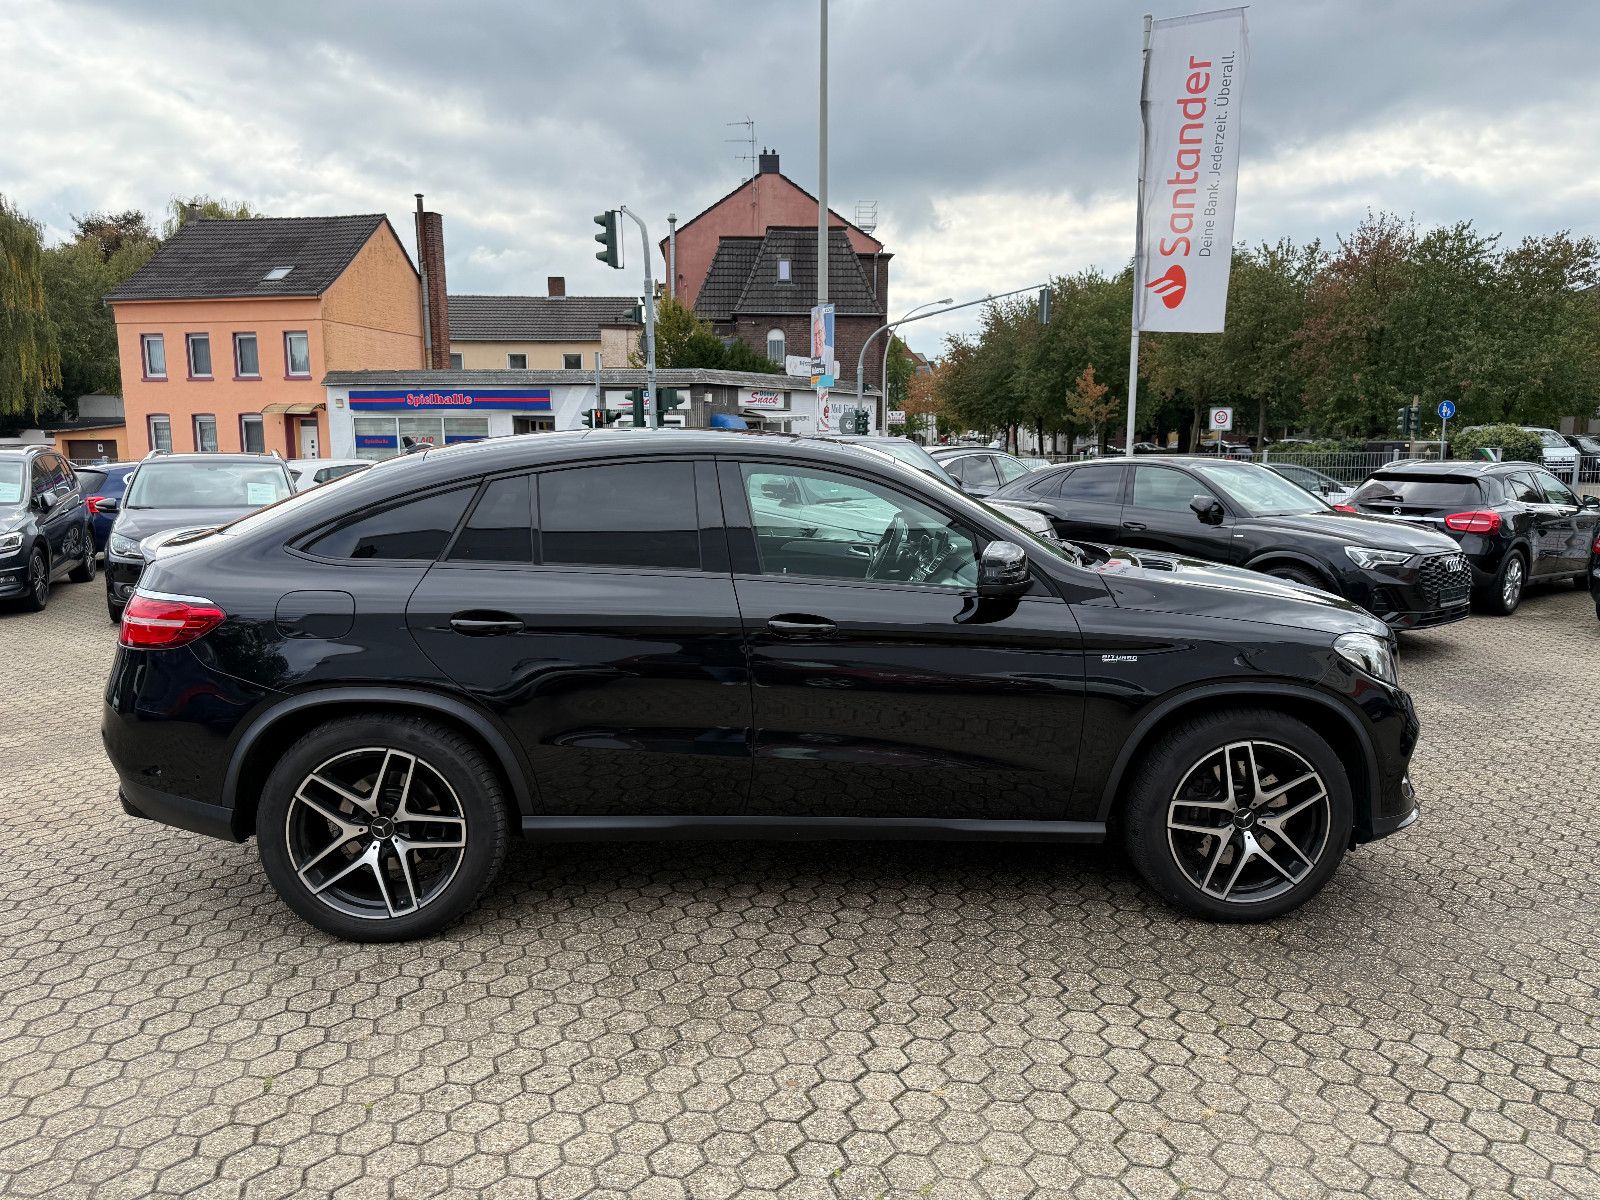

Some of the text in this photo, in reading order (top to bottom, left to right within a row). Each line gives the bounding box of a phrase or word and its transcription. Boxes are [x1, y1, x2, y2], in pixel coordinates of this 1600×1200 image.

[1159, 55, 1212, 257] Santander
[1199, 50, 1235, 257] Deine Bank. Jederzeit. Überall.
[407, 394, 472, 407] Spielhalle
[745, 391, 779, 404] Snack
